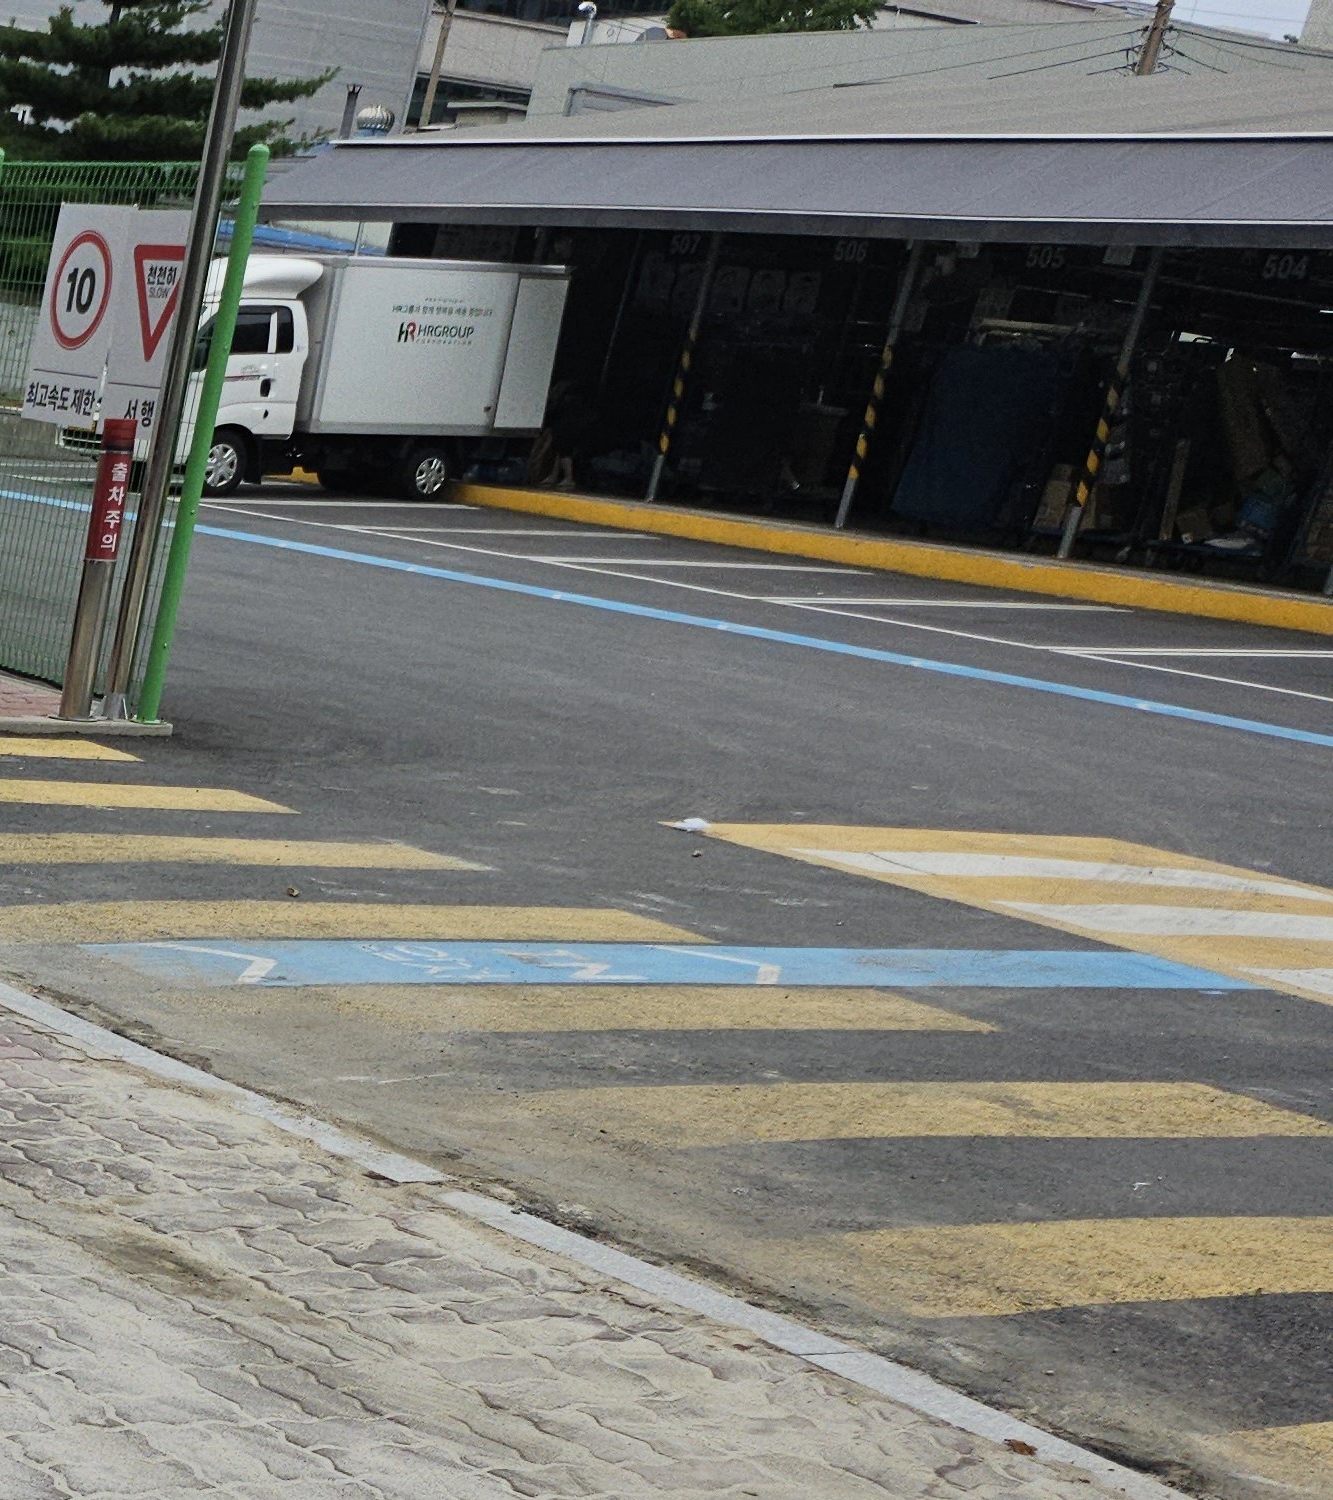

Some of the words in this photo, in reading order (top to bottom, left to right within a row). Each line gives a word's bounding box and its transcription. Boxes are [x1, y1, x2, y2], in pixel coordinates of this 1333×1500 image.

[147, 264, 177, 285] 천천히
[1262, 255, 1308, 280] 504
[65, 267, 96, 314] 10
[149, 287, 170, 299] SLOW
[418, 325, 474, 339] HRGROUP
[26, 382, 70, 412] 최고속도
[71, 388, 96, 416] 제한
[101, 462, 128, 553] 출차주의
